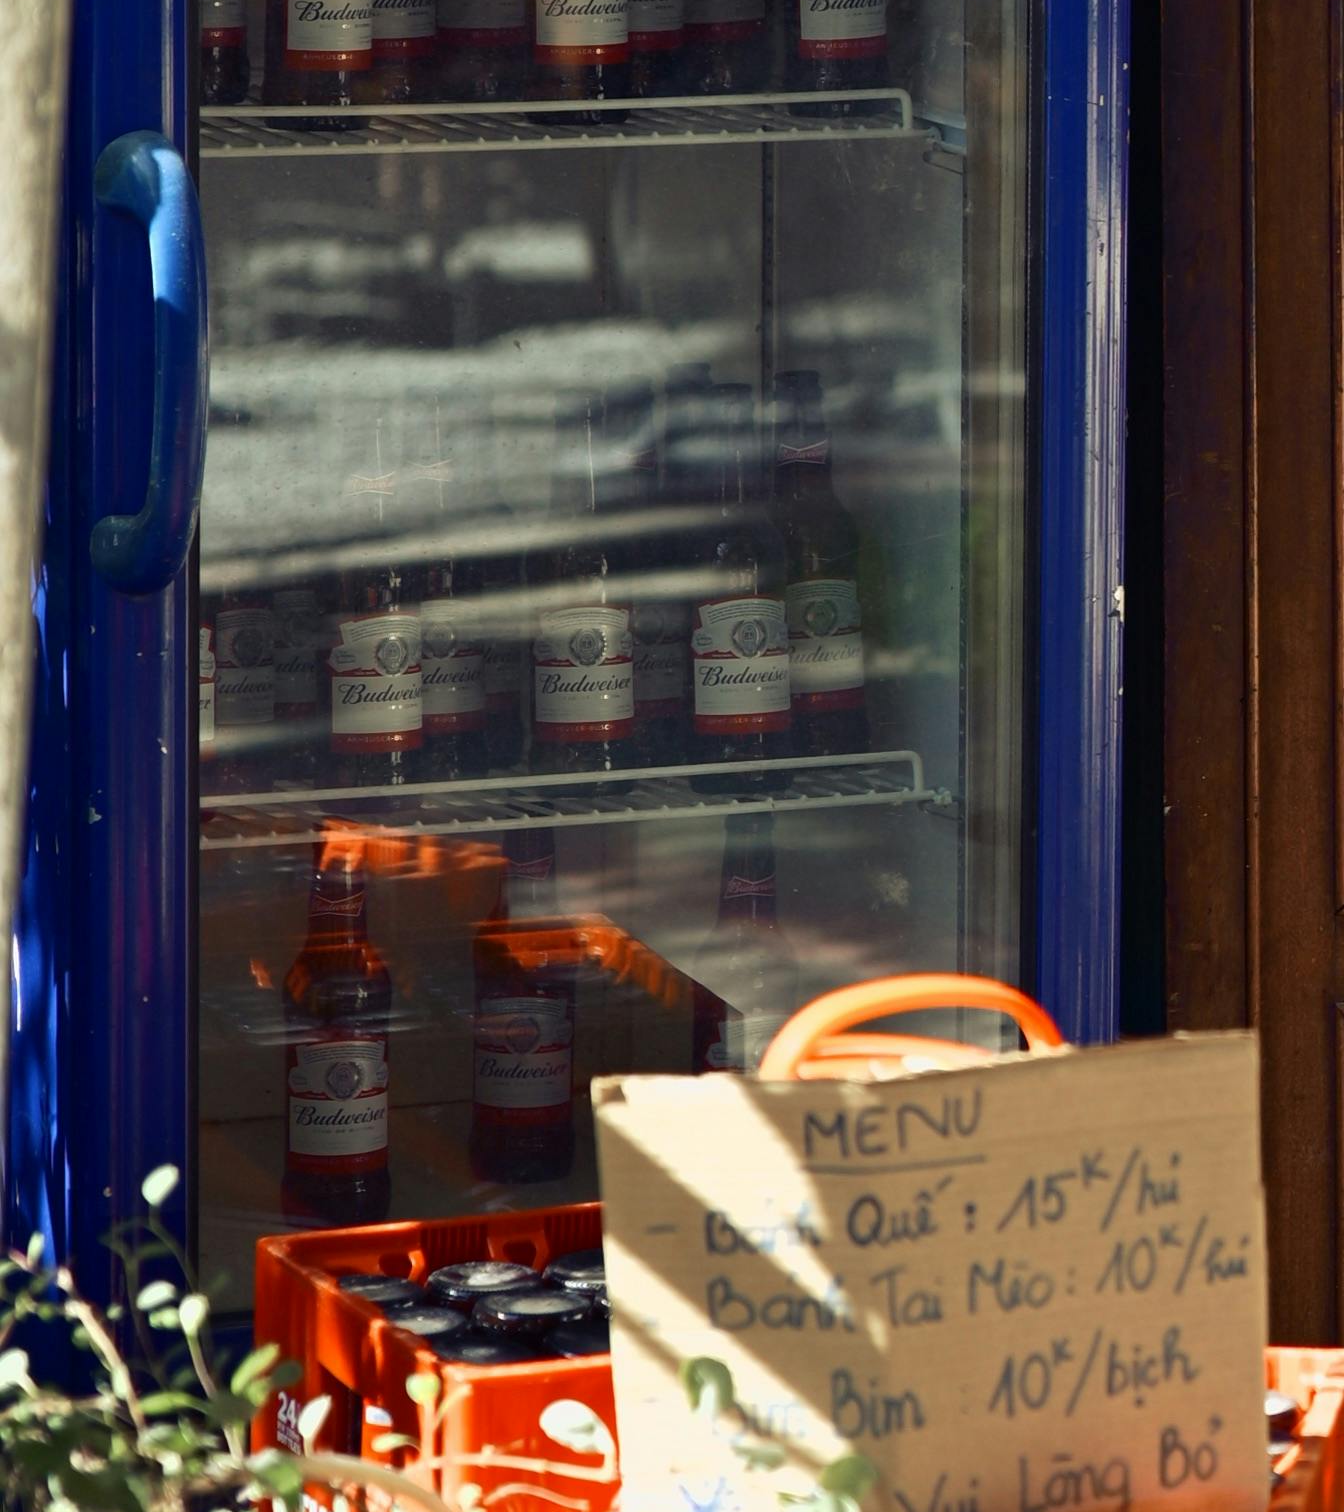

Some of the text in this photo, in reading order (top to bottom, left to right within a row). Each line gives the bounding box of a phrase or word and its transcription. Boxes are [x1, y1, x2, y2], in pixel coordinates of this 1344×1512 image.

[338, 682, 423, 705] Budweise
[540, 672, 633, 696] Budweiser
[294, 1103, 387, 1128] Budweiser
[803, 1088, 985, 1160] MENU
[831, 1367, 925, 1439] Bim
